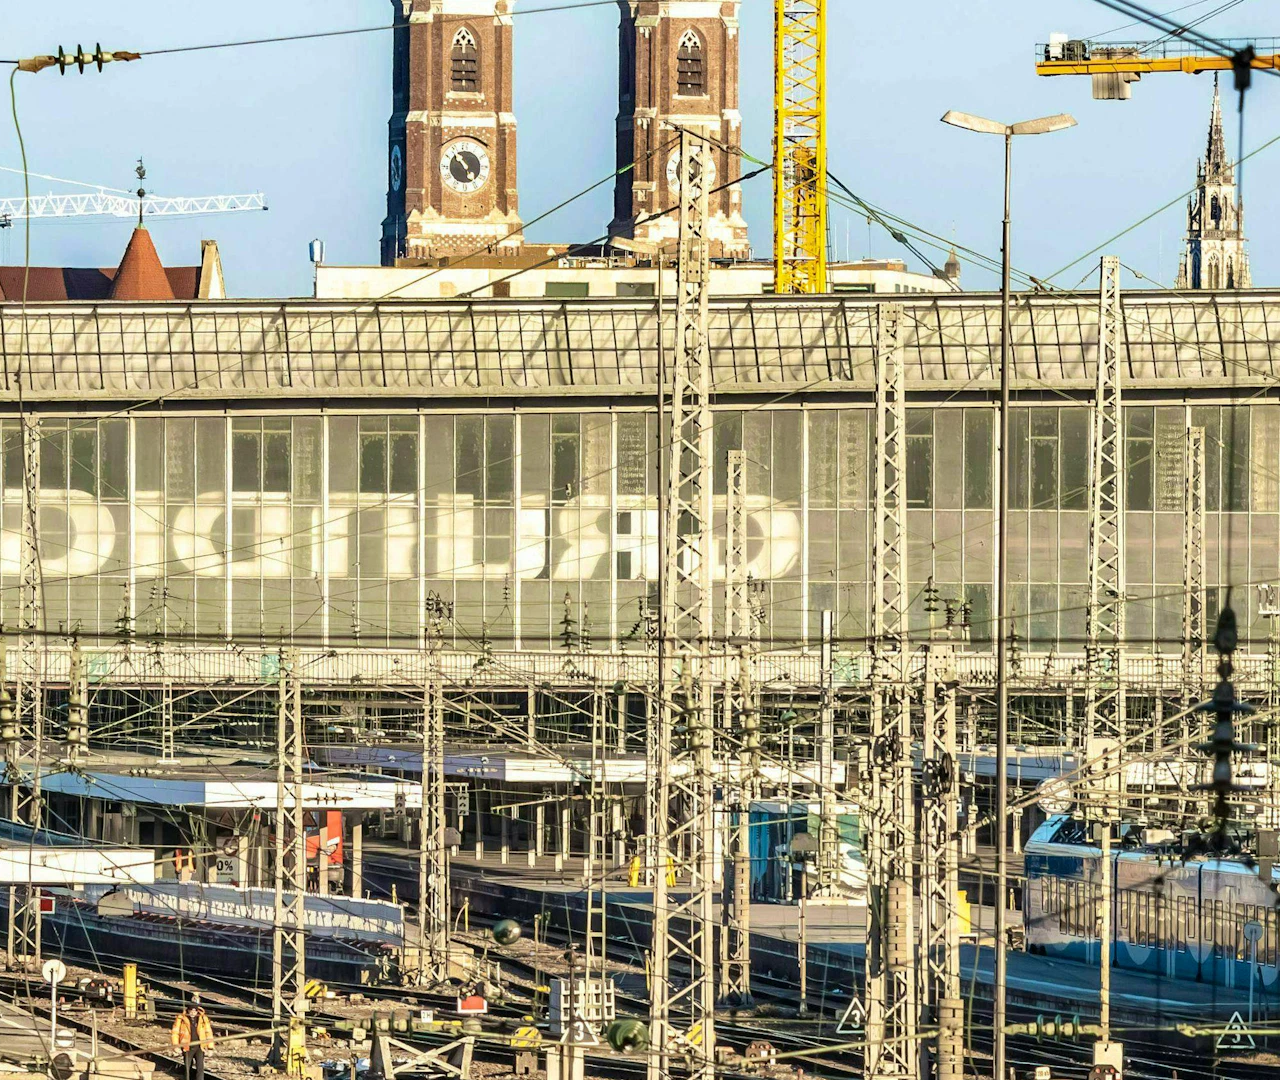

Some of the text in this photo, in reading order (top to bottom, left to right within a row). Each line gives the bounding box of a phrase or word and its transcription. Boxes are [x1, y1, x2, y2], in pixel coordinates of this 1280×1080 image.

[851, 1010, 860, 1028] 3
[574, 1021, 584, 1040] 3
[1232, 1024, 1240, 1043] 3
